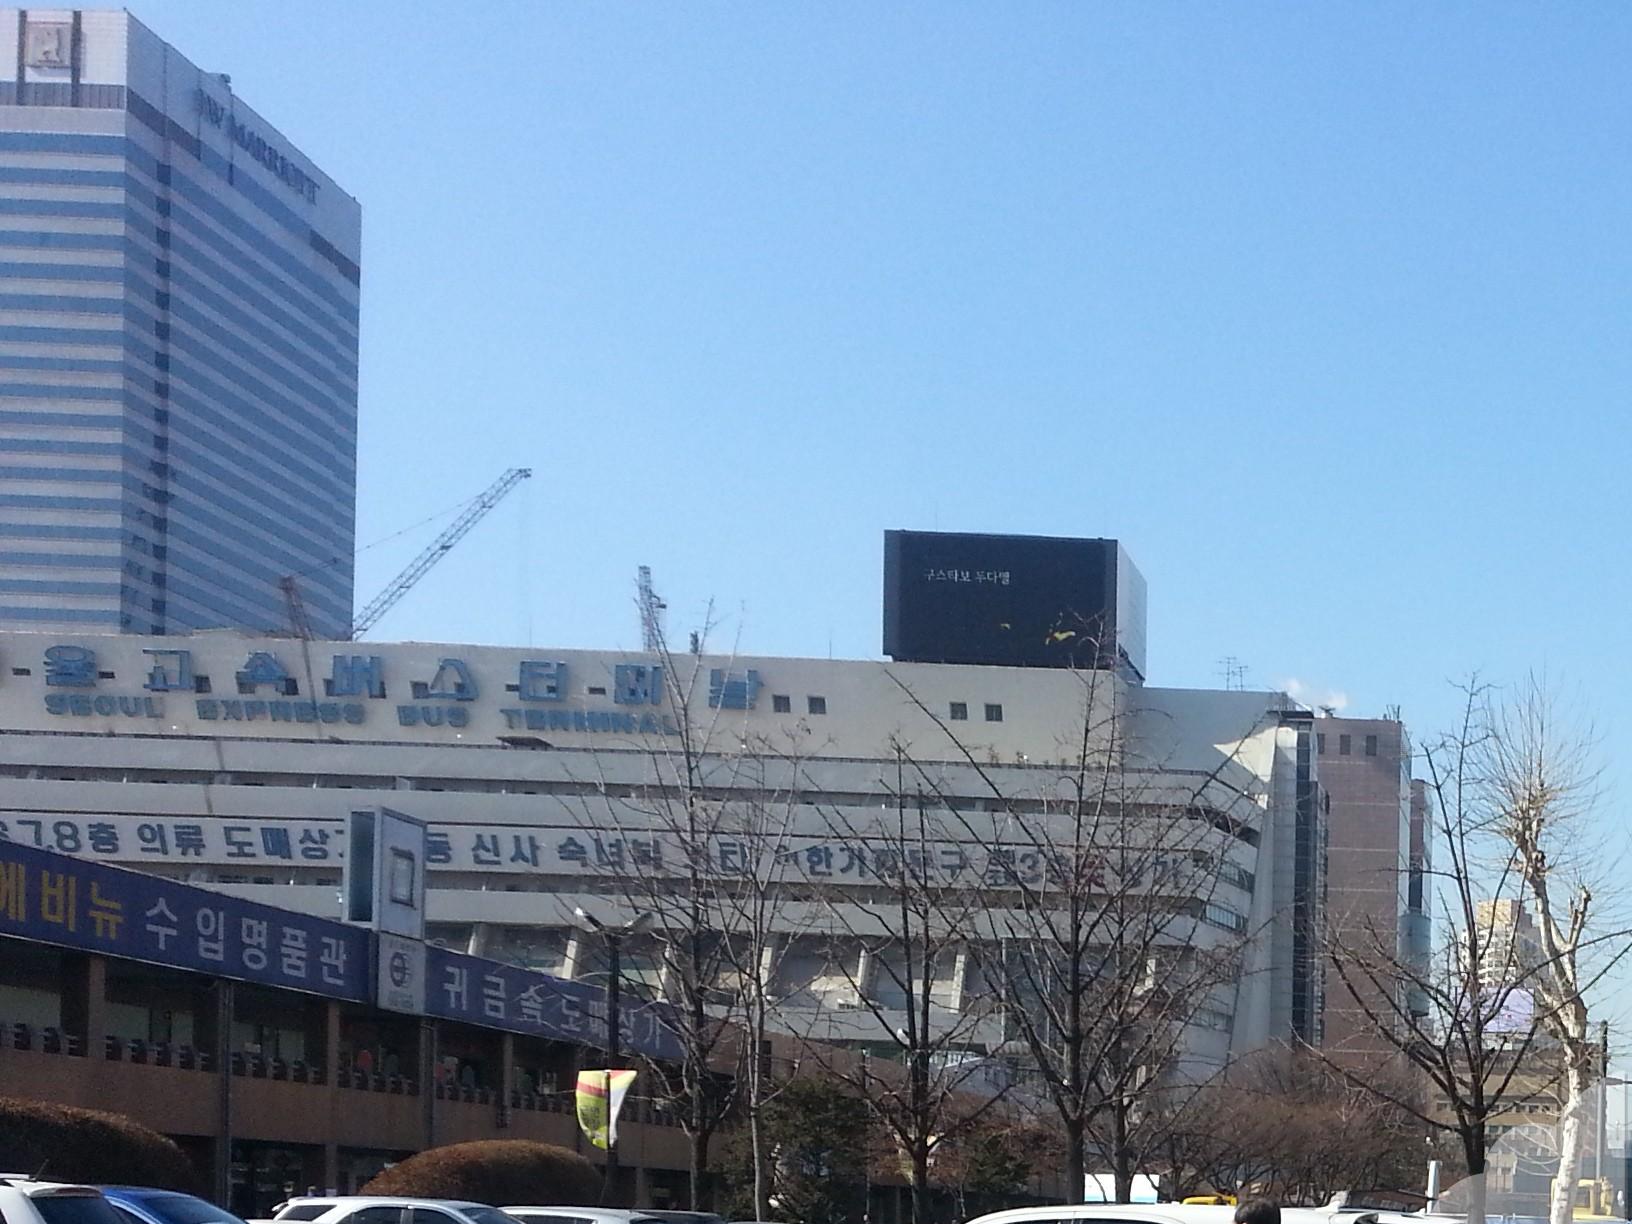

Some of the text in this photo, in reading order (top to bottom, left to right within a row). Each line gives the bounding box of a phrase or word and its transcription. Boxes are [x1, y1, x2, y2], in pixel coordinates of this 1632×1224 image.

[44, 693, 685, 737] SEOUL EXPRESS BUS TERMINAL
[137, 823, 206, 857] 의류
[223, 826, 344, 860] 도매상
[471, 833, 541, 866] 신사
